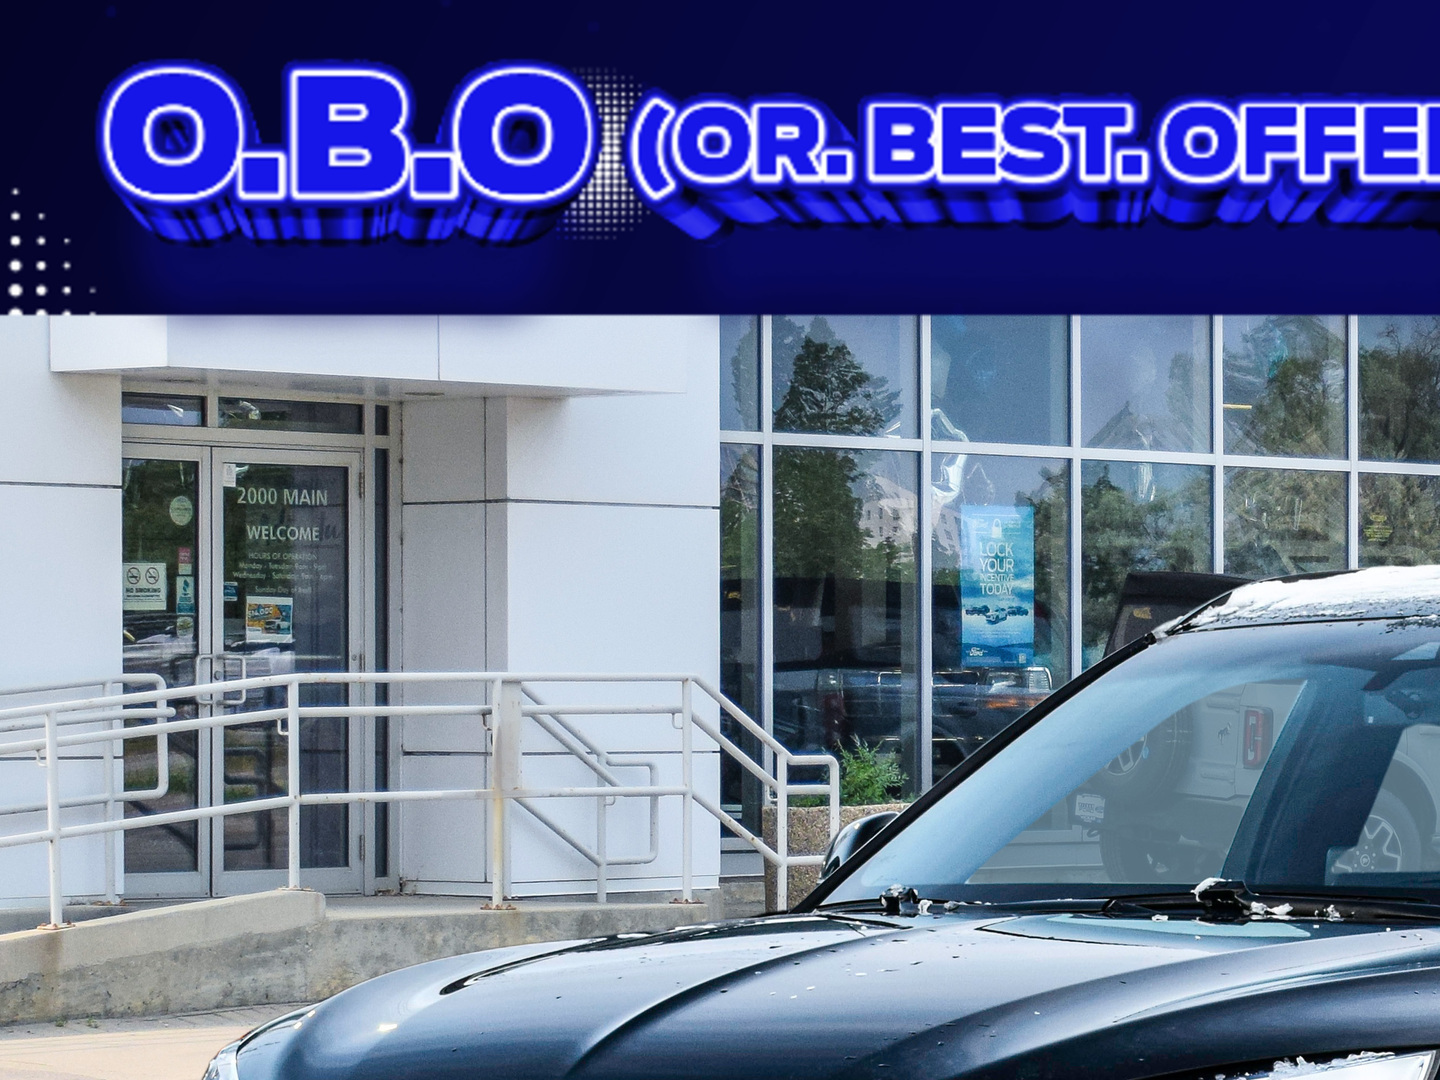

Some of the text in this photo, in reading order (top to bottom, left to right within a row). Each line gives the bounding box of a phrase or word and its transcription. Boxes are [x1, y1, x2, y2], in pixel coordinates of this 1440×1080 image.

[237, 487, 328, 506] 2000 MAIN
[246, 525, 320, 541] WELCOME
[979, 542, 1014, 557] LOCK
[979, 558, 1015, 573] YOUR
[979, 583, 1014, 596] TODAY
